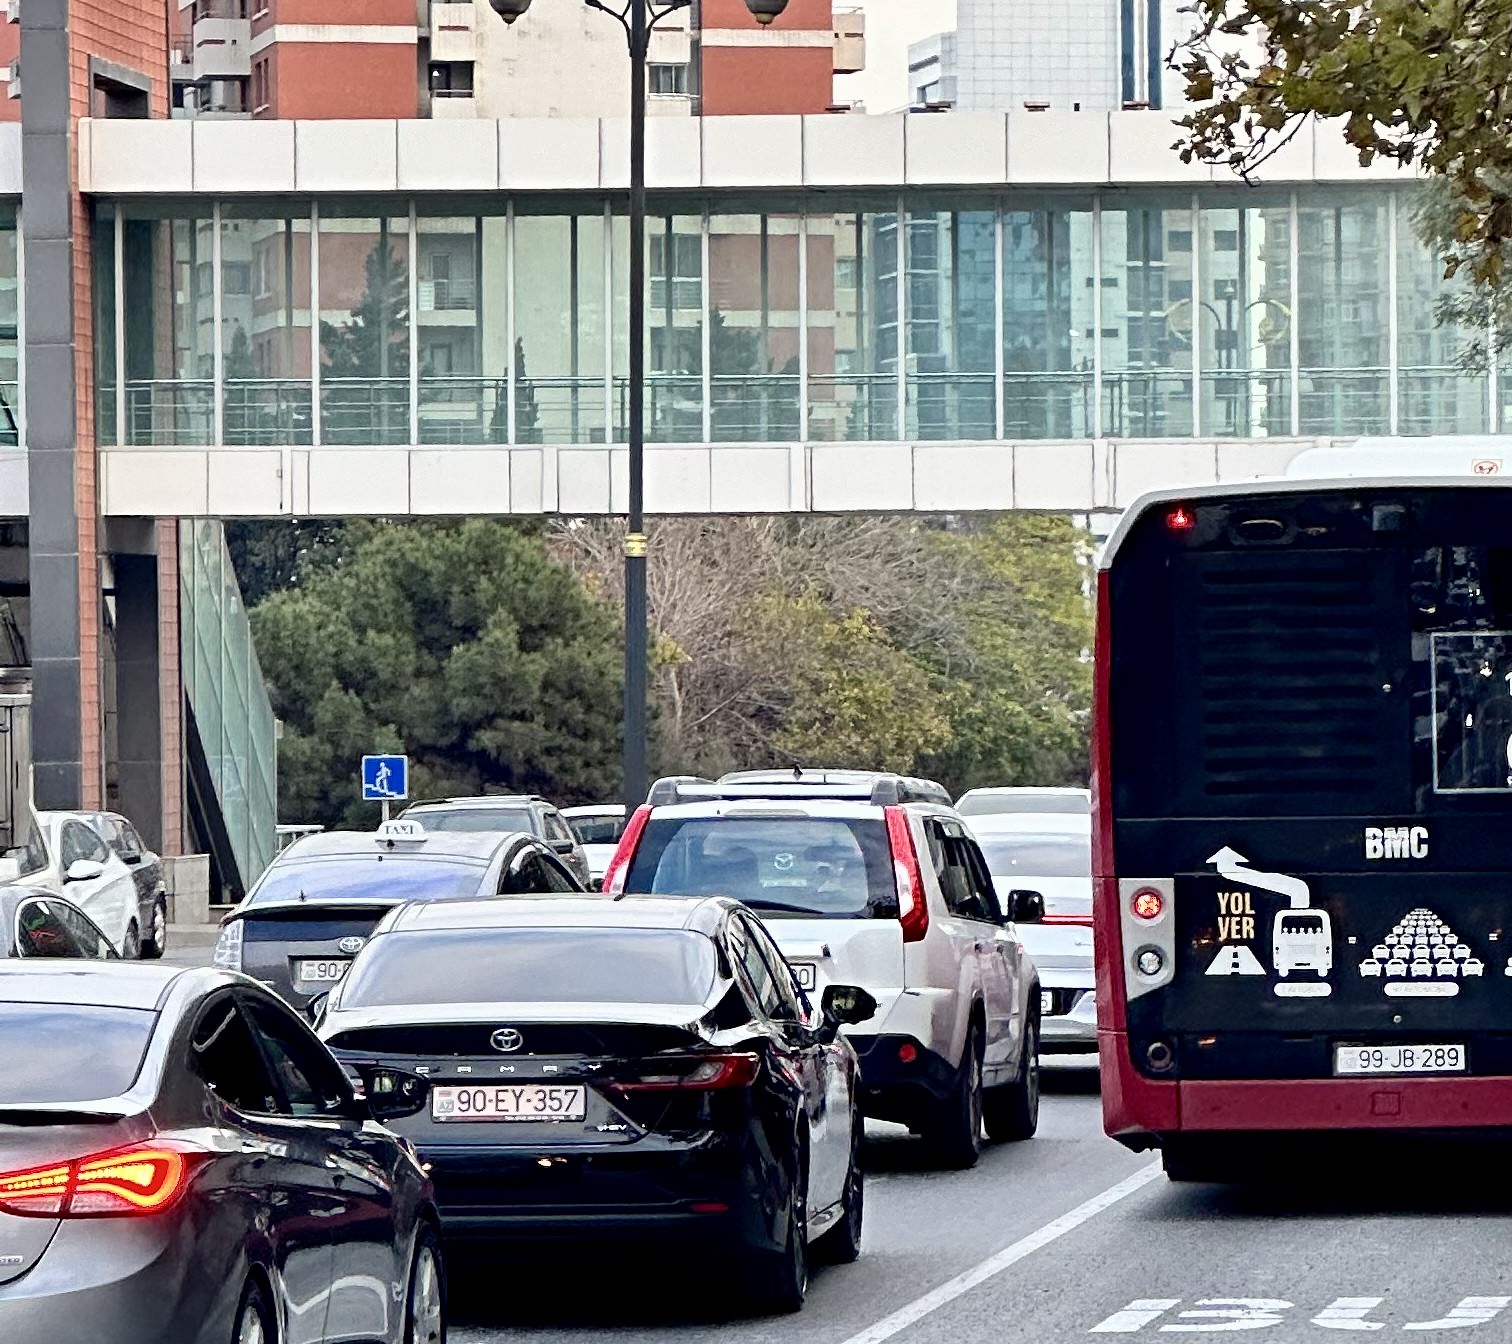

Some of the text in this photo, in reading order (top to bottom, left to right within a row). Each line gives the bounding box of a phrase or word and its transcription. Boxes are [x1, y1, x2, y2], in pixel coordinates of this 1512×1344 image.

[384, 824, 414, 835] TAXI
[1365, 826, 1429, 859] BMC
[1217, 891, 1256, 915] YOL
[1217, 916, 1256, 940] VER
[1358, 1047, 1459, 1069] 99-JB-289
[456, 1088, 579, 1113] 90-EY-357
